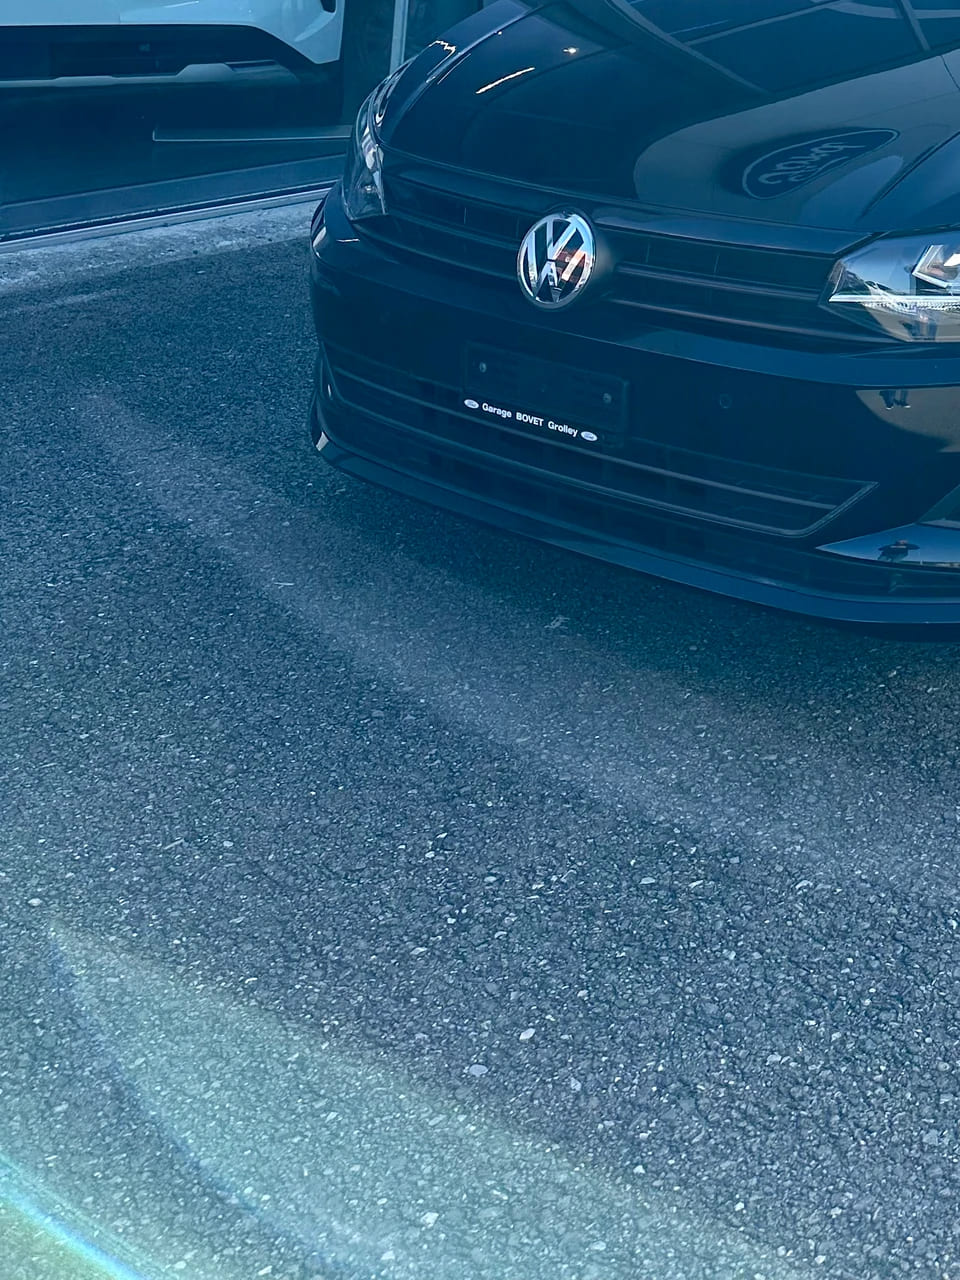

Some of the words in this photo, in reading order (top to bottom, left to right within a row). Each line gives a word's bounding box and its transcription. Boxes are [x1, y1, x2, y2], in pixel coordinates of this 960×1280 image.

[482, 402, 512, 418] Garage
[516, 411, 544, 427] BOVET
[548, 421, 578, 437] Grolley
